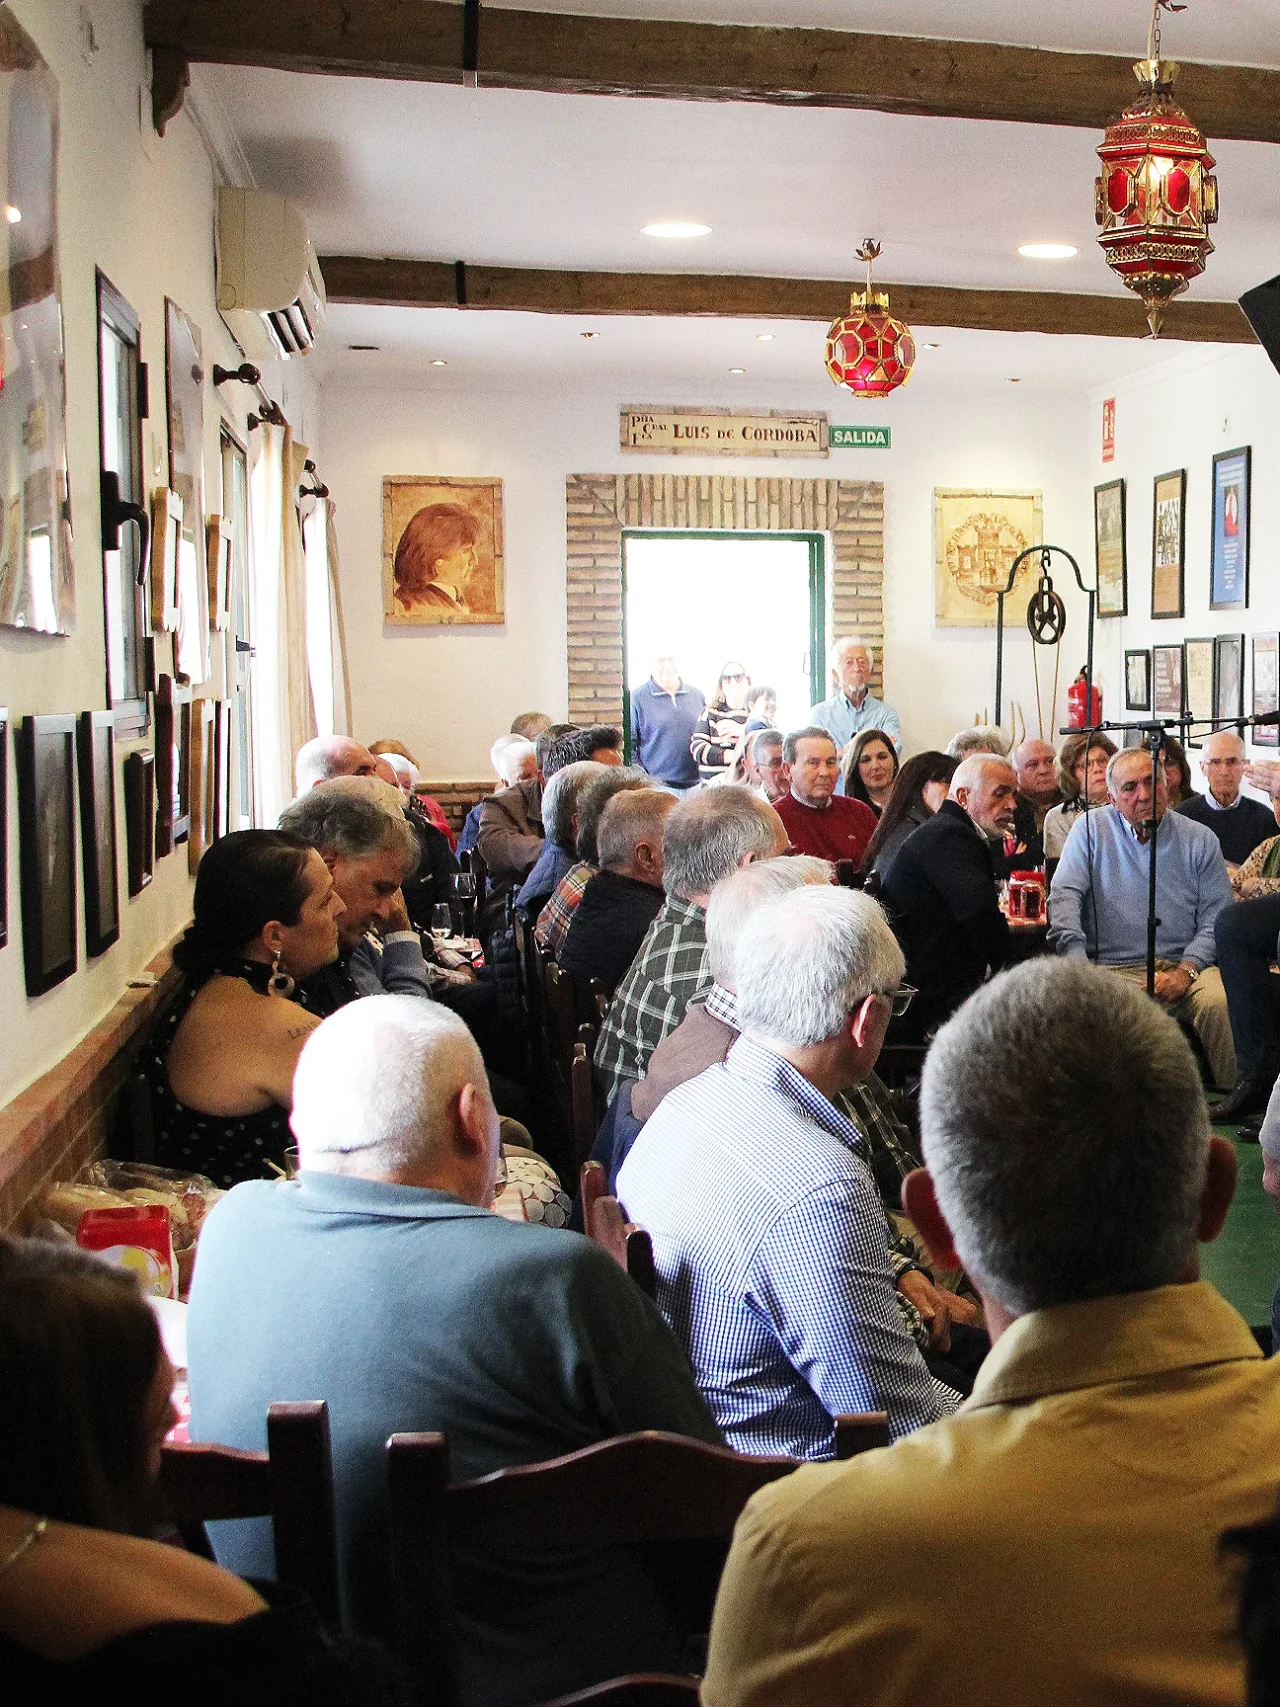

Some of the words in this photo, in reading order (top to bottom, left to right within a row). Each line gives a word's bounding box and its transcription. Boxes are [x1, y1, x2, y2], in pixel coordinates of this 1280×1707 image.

[673, 424, 709, 439] LUIS
[717, 429, 734, 439] DE
[741, 426, 817, 442] CORDOBA
[834, 431, 886, 444] SALIDA
